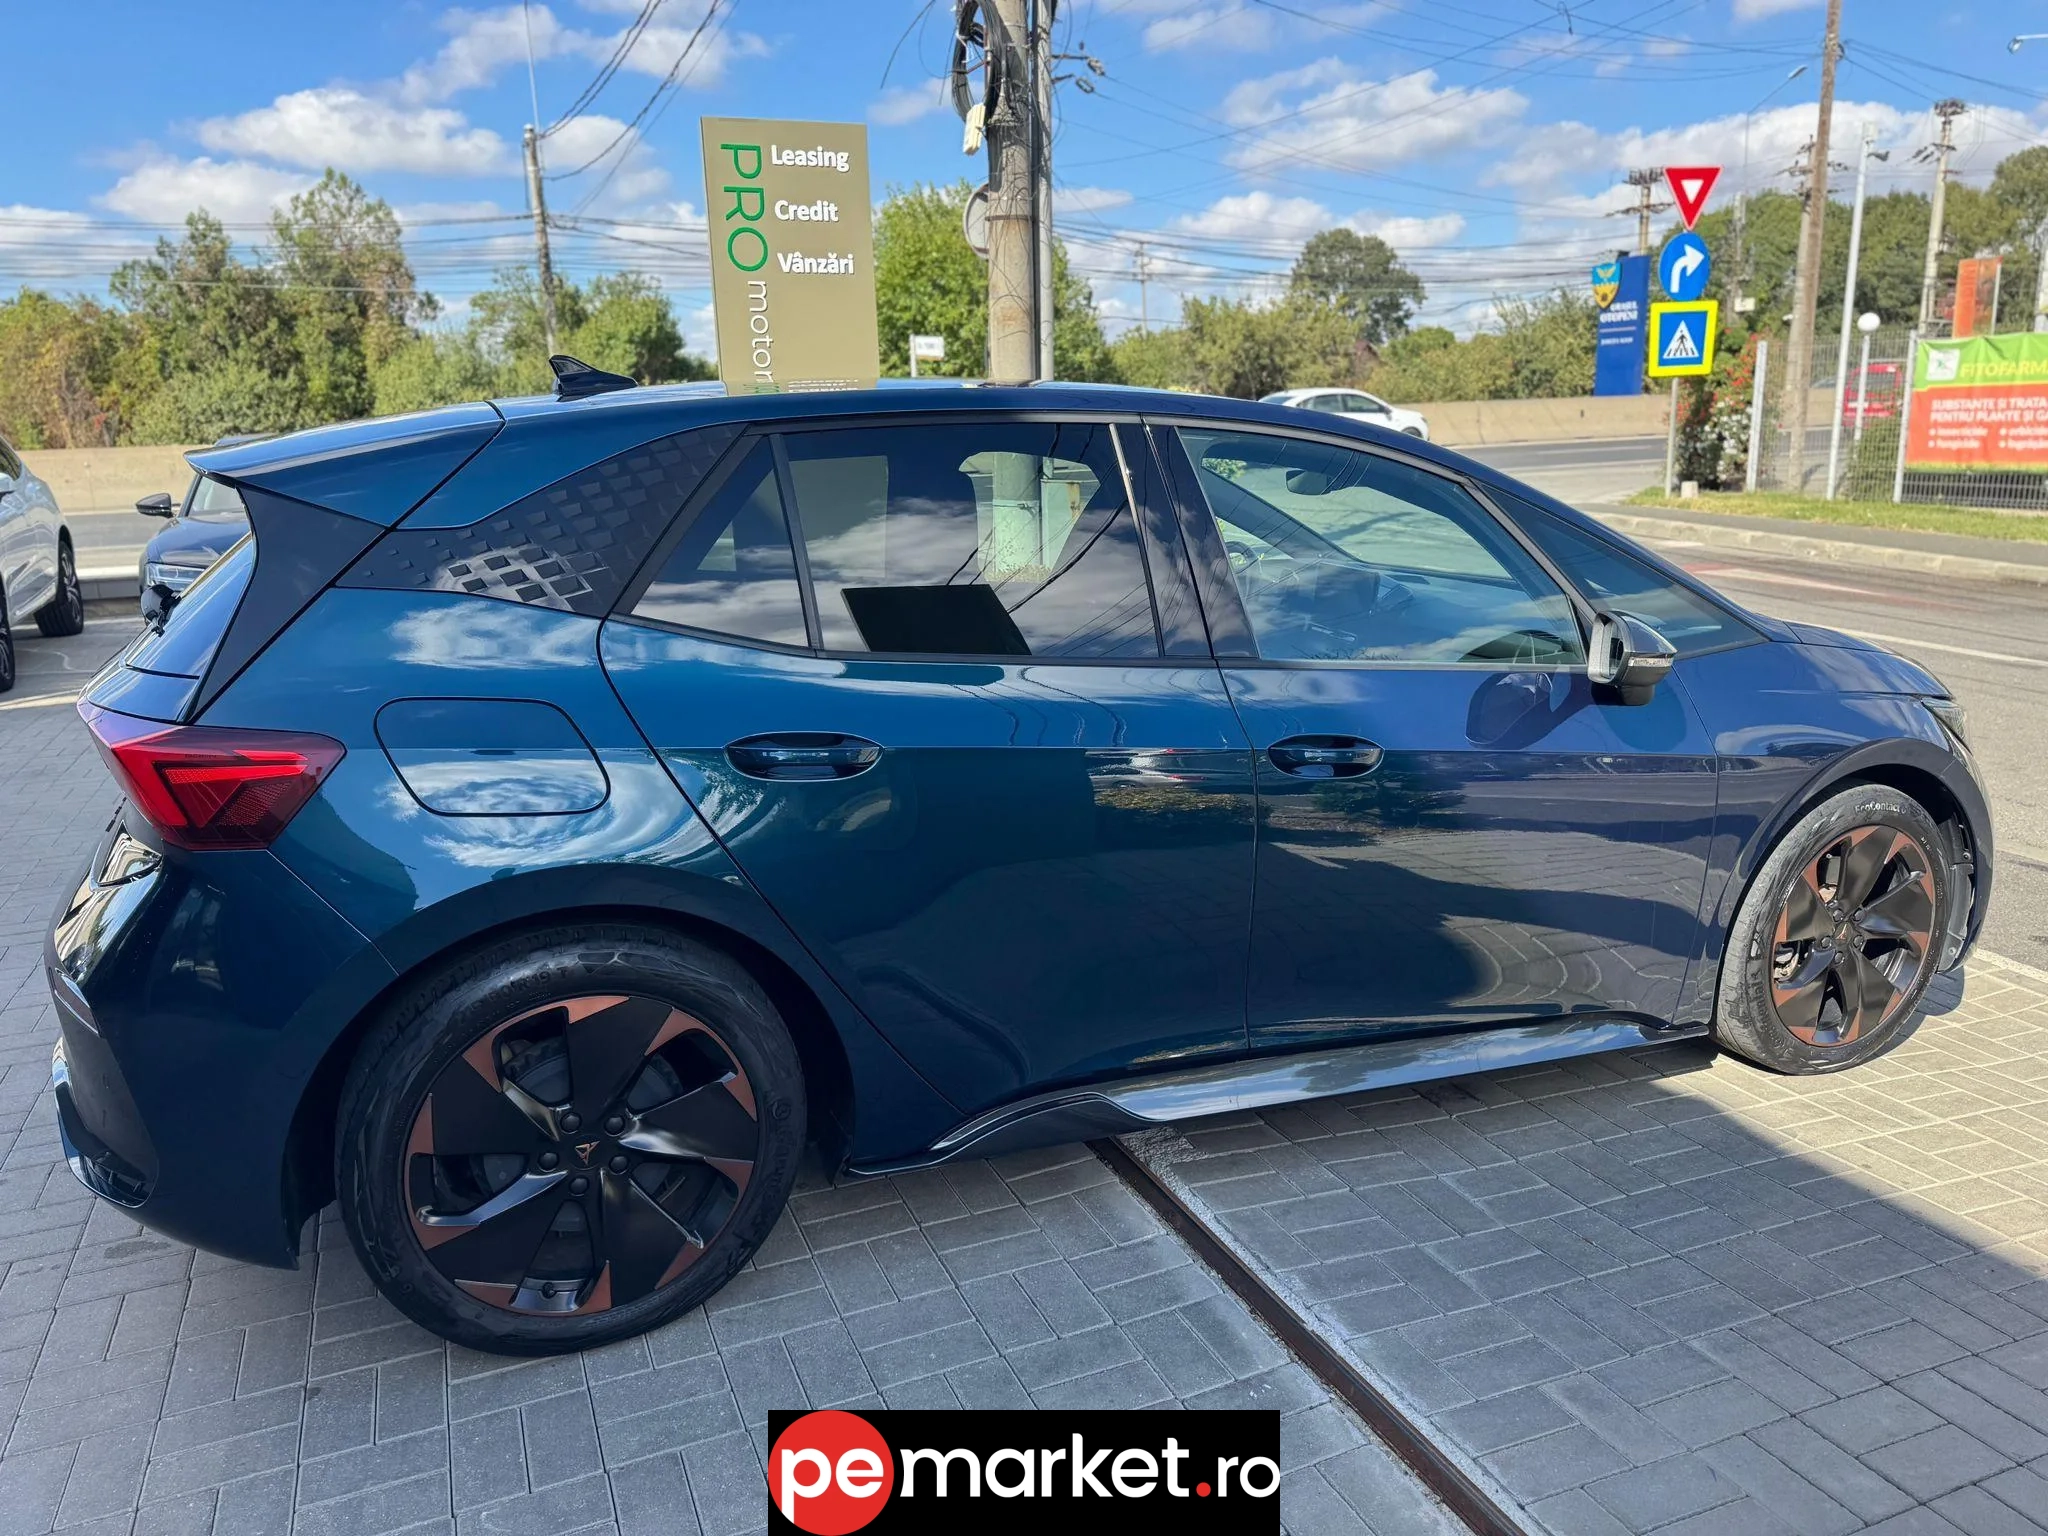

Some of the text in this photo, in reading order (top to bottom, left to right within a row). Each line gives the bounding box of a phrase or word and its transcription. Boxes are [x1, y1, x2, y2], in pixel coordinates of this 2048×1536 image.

[771, 144, 850, 173] Leasing
[774, 199, 840, 222] Credit
[777, 252, 855, 275] Vânzări
[1960, 361, 2048, 378] FITOFARM
